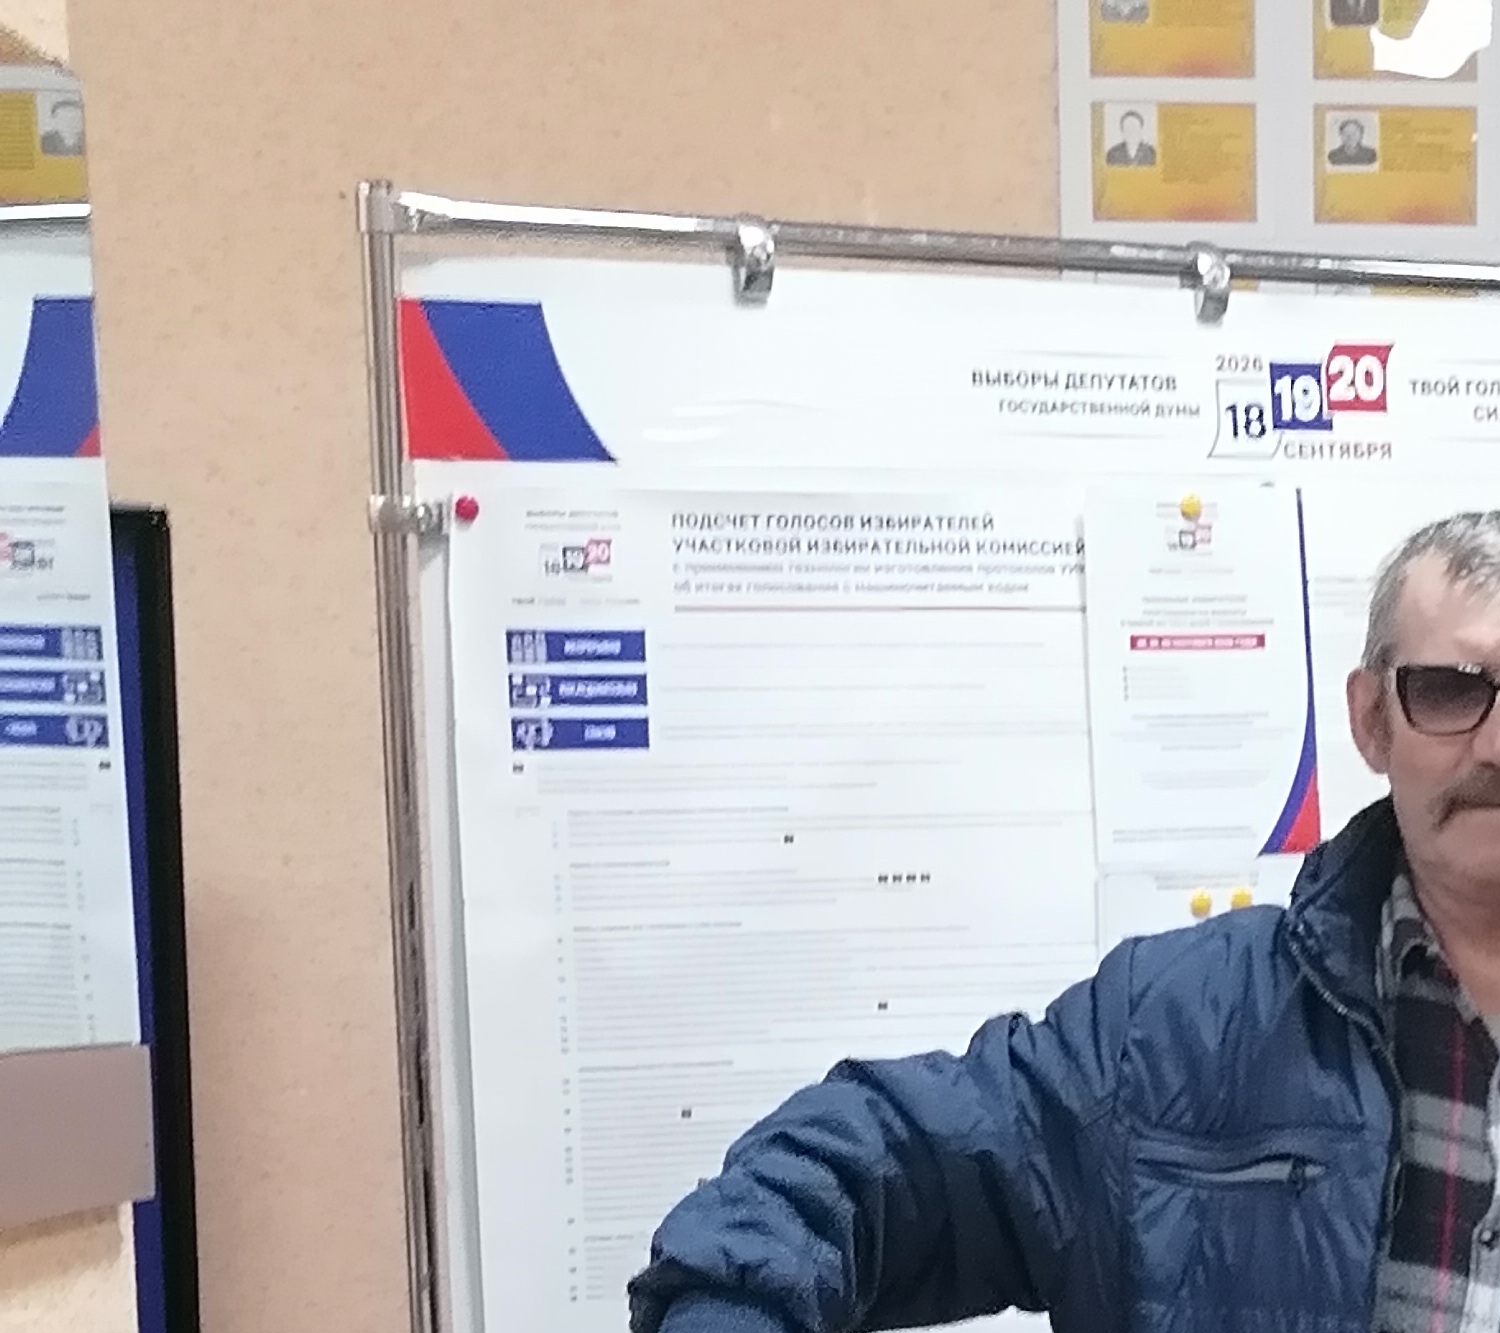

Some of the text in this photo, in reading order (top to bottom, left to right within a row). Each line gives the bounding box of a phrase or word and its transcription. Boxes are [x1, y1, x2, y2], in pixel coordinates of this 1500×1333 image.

[1216, 354, 1263, 373] 2026
[971, 369, 1177, 392] ВЫБОРЫ ДЕПУТАТОВ
[1328, 354, 1385, 402] 20
[1409, 377, 1459, 397] ТВОЙ
[998, 398, 1200, 417] ГОСУДАРСТВЕННОЙ ДУМЫ
[1275, 374, 1322, 422] 19
[1224, 403, 1267, 439] 18
[1283, 442, 1393, 460] СЕНТЯБРЯ
[672, 511, 995, 532] ПОДСЧЕТ ГОЛОСОВ ИЗБИРАТЕЛЕЙ
[672, 537, 1085, 557] УЧАСТКОВОЙ ИЗБИРАТЕЛЬНОЙ КОМИССИЕЙ
